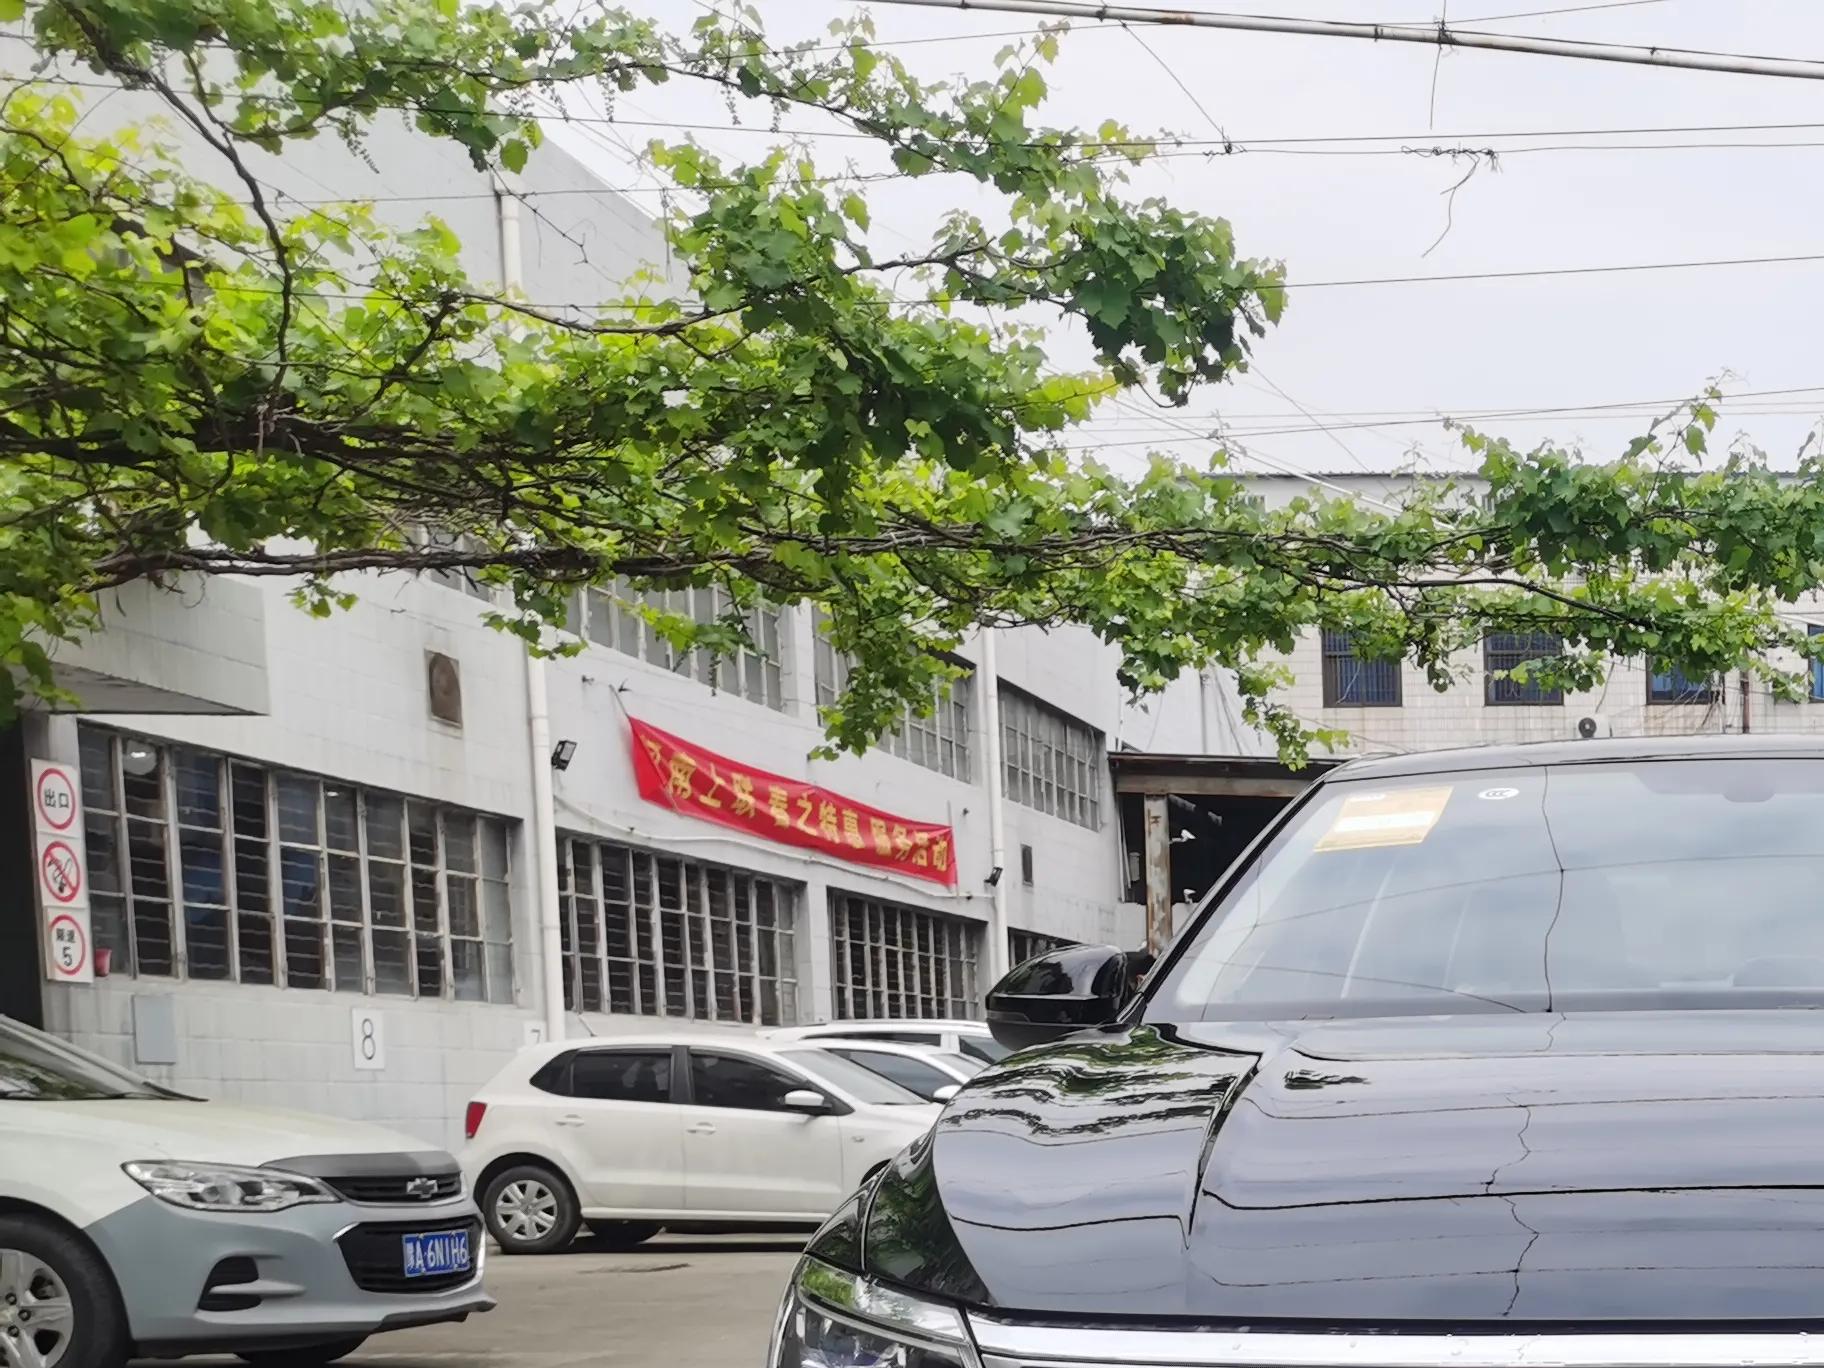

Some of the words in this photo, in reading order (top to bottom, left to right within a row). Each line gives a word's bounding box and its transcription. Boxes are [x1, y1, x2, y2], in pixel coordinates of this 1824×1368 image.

[44, 788, 70, 808] 出口
[62, 947, 73, 966] 5
[362, 1018, 377, 1061] 8
